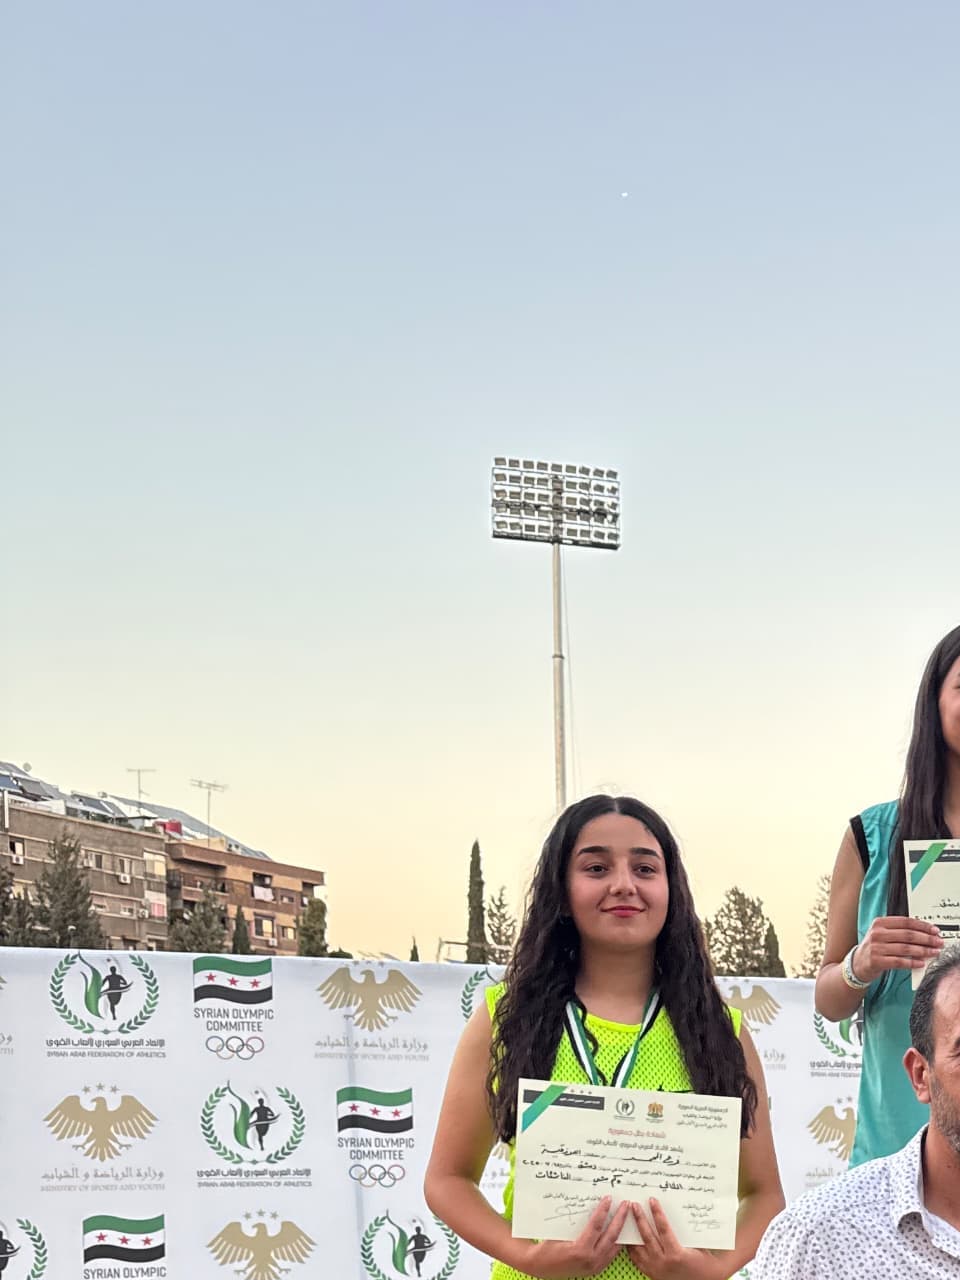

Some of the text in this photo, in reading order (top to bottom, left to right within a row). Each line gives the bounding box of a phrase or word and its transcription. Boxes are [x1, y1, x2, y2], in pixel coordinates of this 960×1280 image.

[194, 1008, 274, 1020] SYRIAN OLYMPIC
[206, 1020, 263, 1032] COMMITTEE
[338, 1137, 415, 1149] SYRIAN OLYMPIC
[350, 1149, 404, 1160] COMMITTEE
[83, 1266, 167, 1280] SYRIAN OLYMPIC
